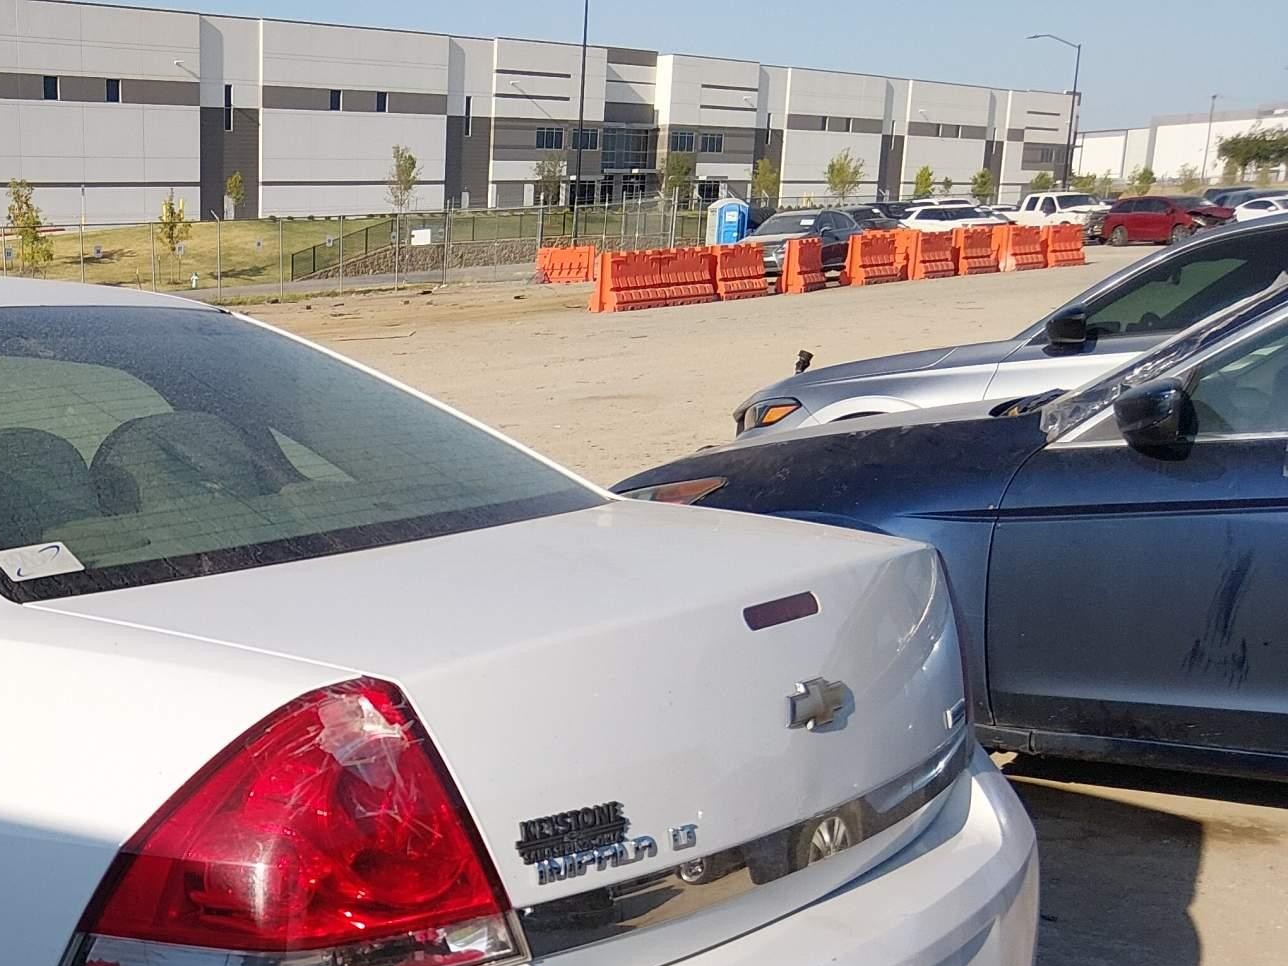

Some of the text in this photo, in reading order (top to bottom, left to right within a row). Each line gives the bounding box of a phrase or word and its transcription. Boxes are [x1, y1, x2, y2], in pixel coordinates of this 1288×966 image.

[519, 801, 624, 842] KEYSTONE
[535, 836, 658, 885] IMPALA
[668, 824, 699, 852] LT
